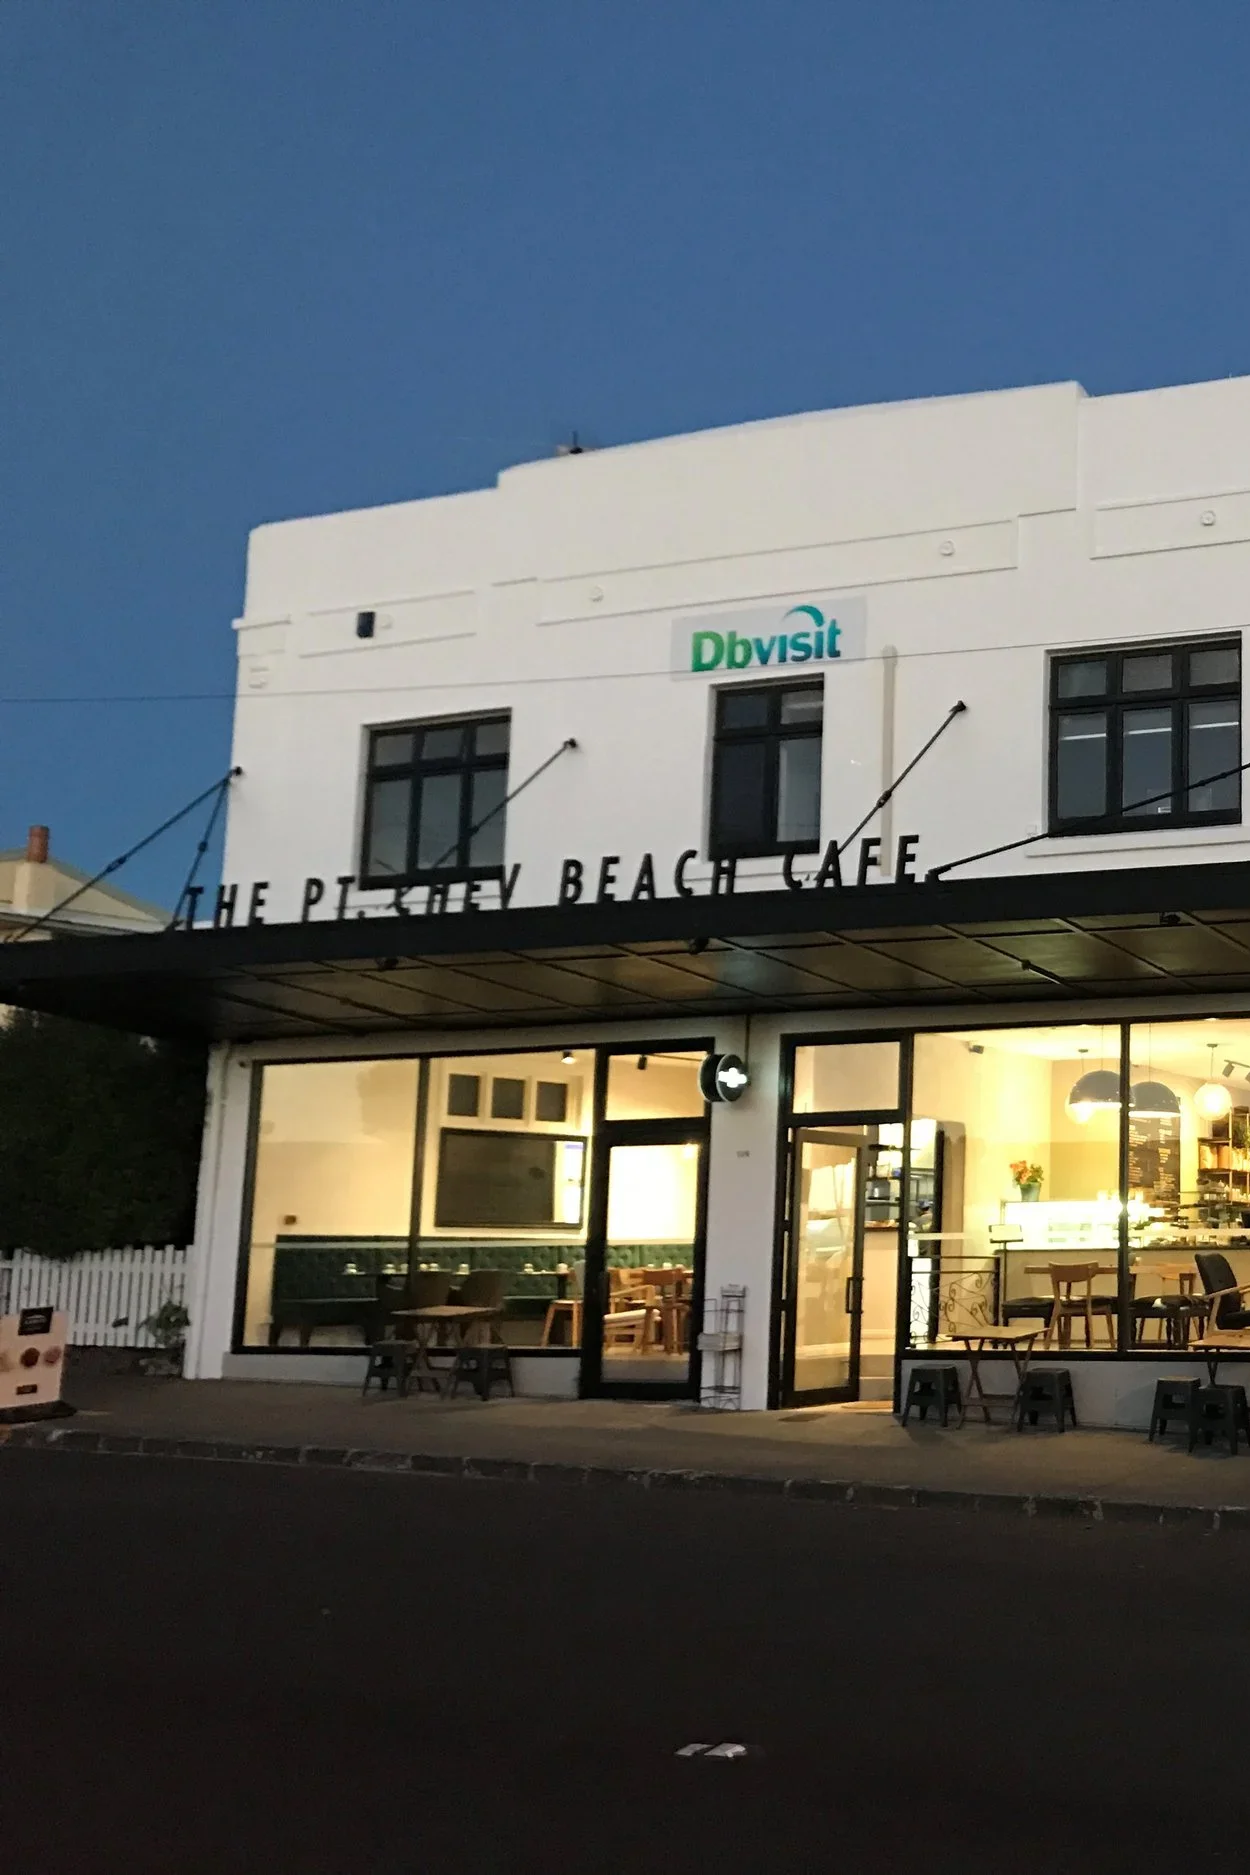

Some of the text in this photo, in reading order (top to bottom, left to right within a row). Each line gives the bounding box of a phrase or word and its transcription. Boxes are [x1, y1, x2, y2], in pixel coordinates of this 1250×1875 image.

[691, 605, 842, 672] Dbvisit
[185, 834, 919, 930] THE PT. CHEV BEACH CAFE
